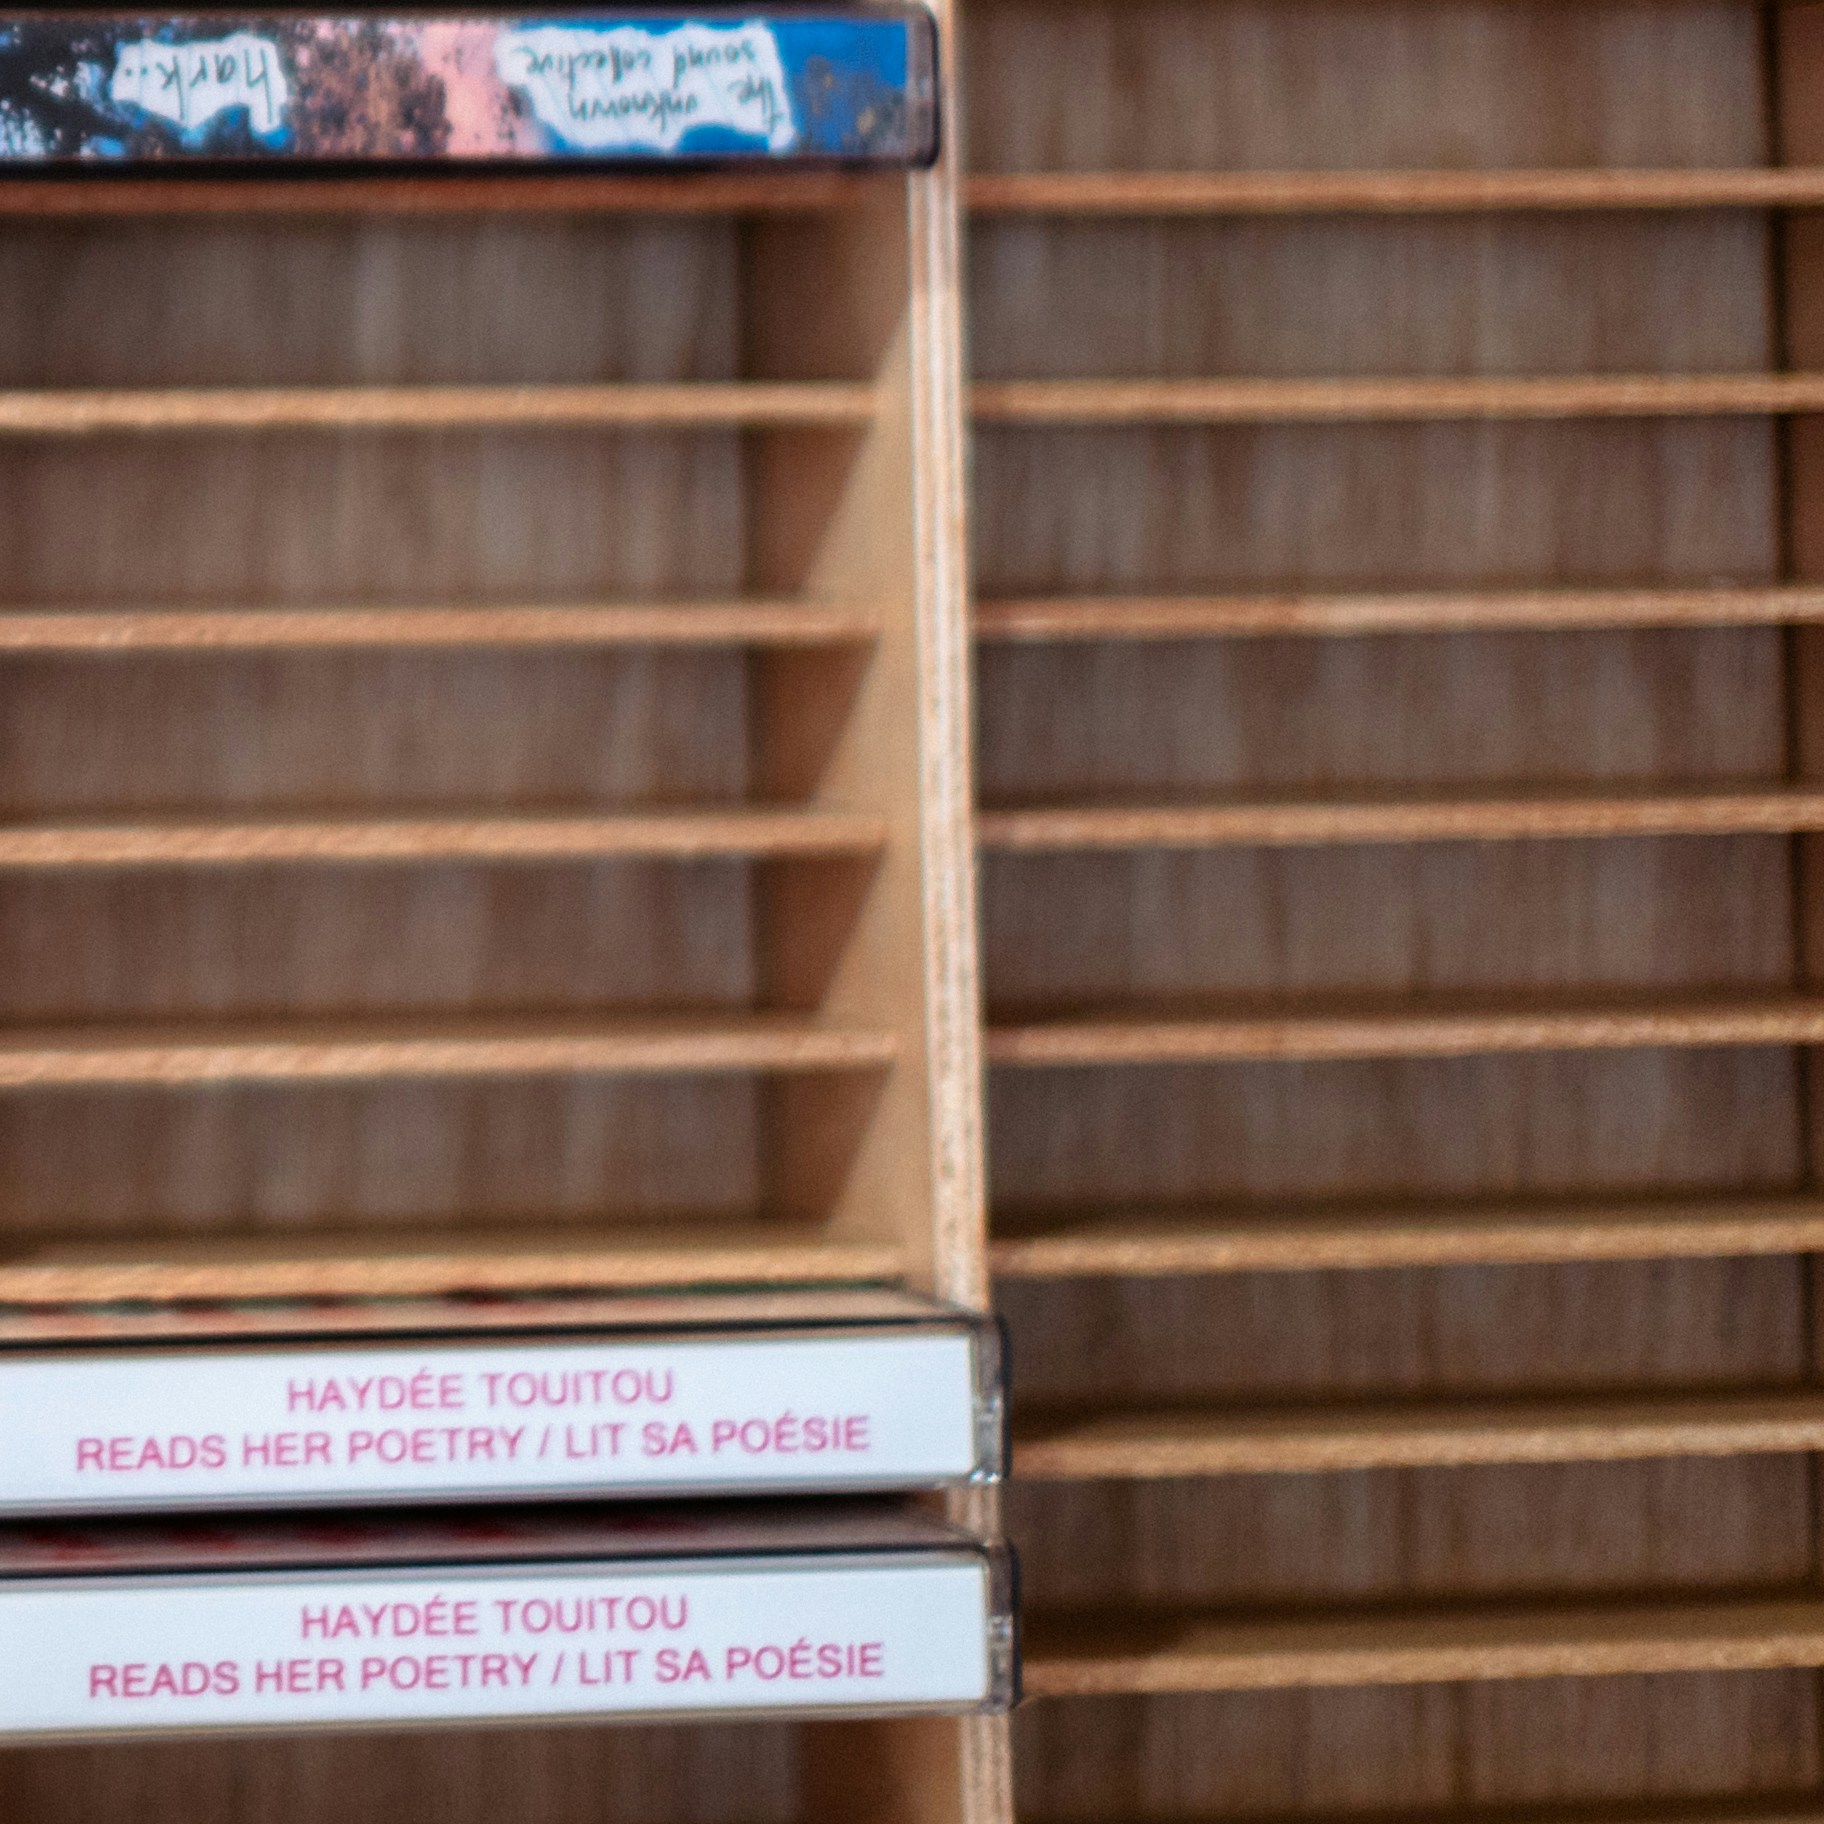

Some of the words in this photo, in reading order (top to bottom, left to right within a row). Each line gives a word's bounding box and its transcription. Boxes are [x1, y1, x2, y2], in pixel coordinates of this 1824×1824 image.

[286, 1365, 466, 1415] HAYDÉE
[480, 1367, 675, 1409] TOUITOU
[75, 1433, 225, 1474] READS
[240, 1430, 331, 1469] HER
[346, 1425, 523, 1467] POETRY
[535, 1422, 549, 1461] /
[563, 1421, 630, 1460] LIT
[640, 1420, 698, 1459] SA
[710, 1414, 871, 1457] POÉSIE
[300, 1592, 479, 1642] HAYDÉE
[492, 1594, 689, 1635] TOUITOU
[86, 1660, 240, 1701] READS
[253, 1656, 345, 1696] HER
[359, 1653, 537, 1692] POETRY
[550, 1650, 565, 1687] /
[577, 1648, 644, 1686] LIT
[654, 1646, 712, 1684] SA
[725, 1640, 885, 1682] POÉSIE
